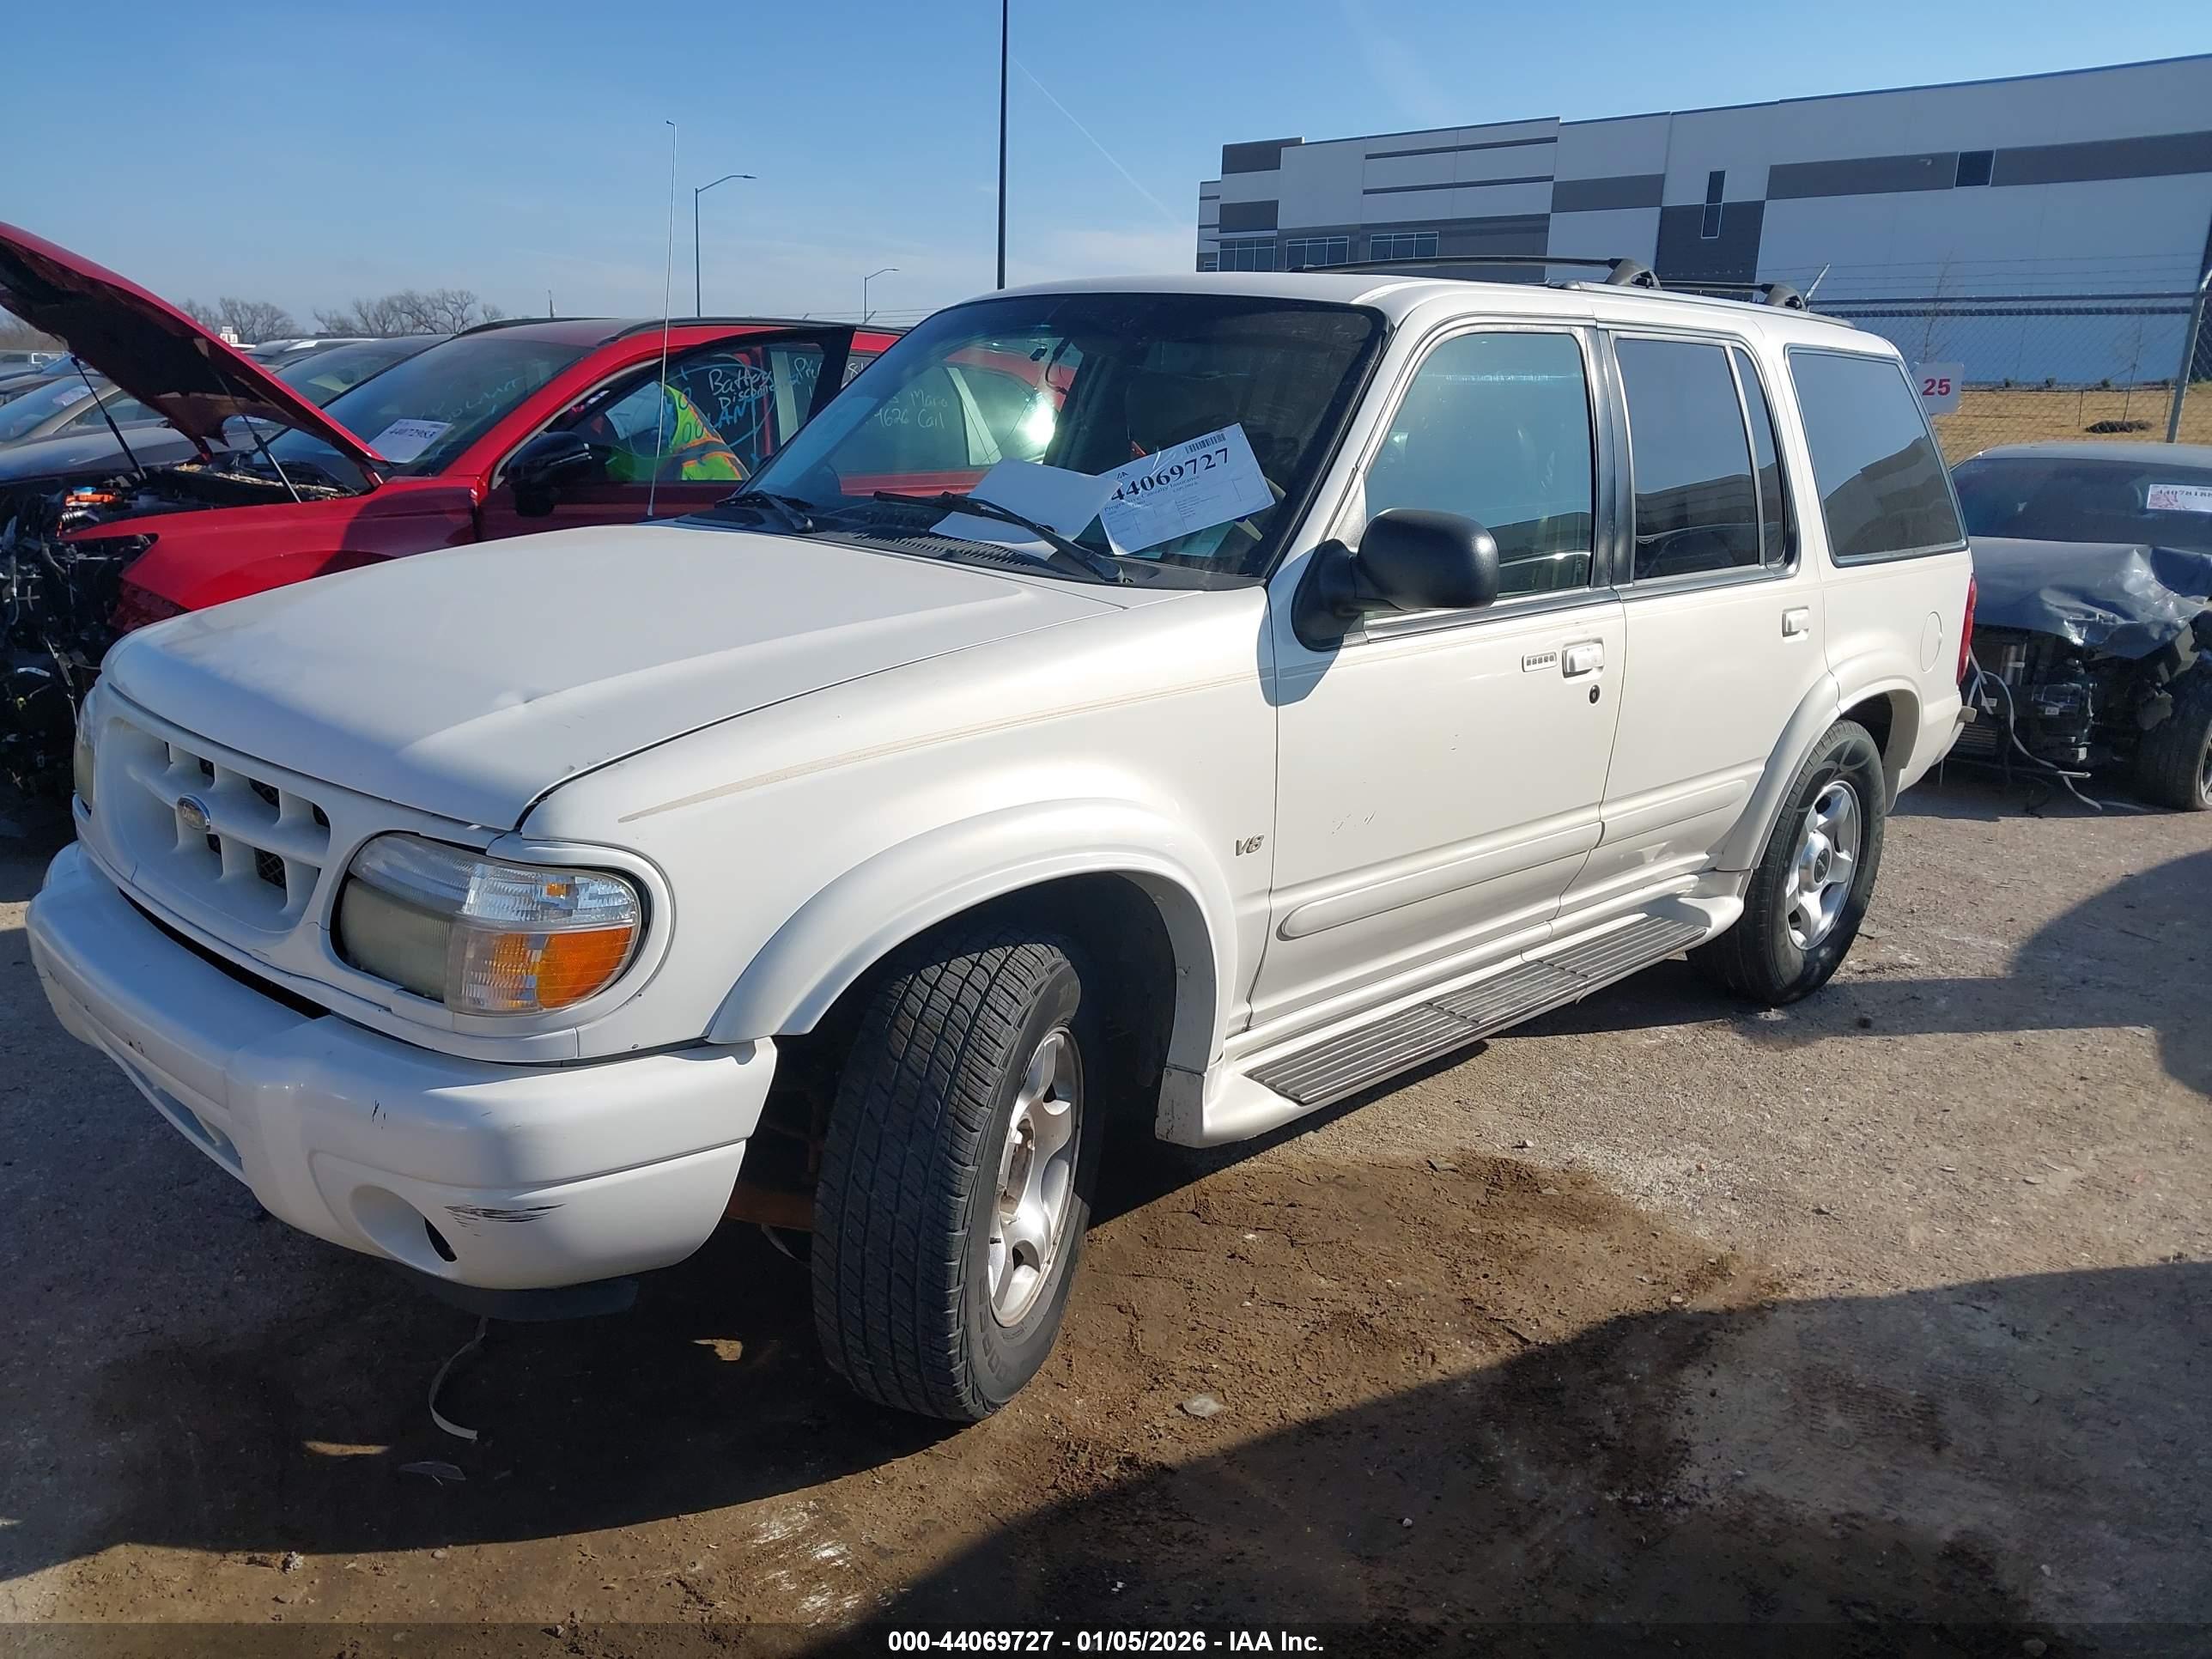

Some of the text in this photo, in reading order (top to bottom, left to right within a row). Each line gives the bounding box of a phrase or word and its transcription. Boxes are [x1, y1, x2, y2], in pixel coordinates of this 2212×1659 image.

[1923, 378, 1951, 396] 25
[1110, 447, 1229, 501] 44069727
[1236, 834, 1265, 856] V6
